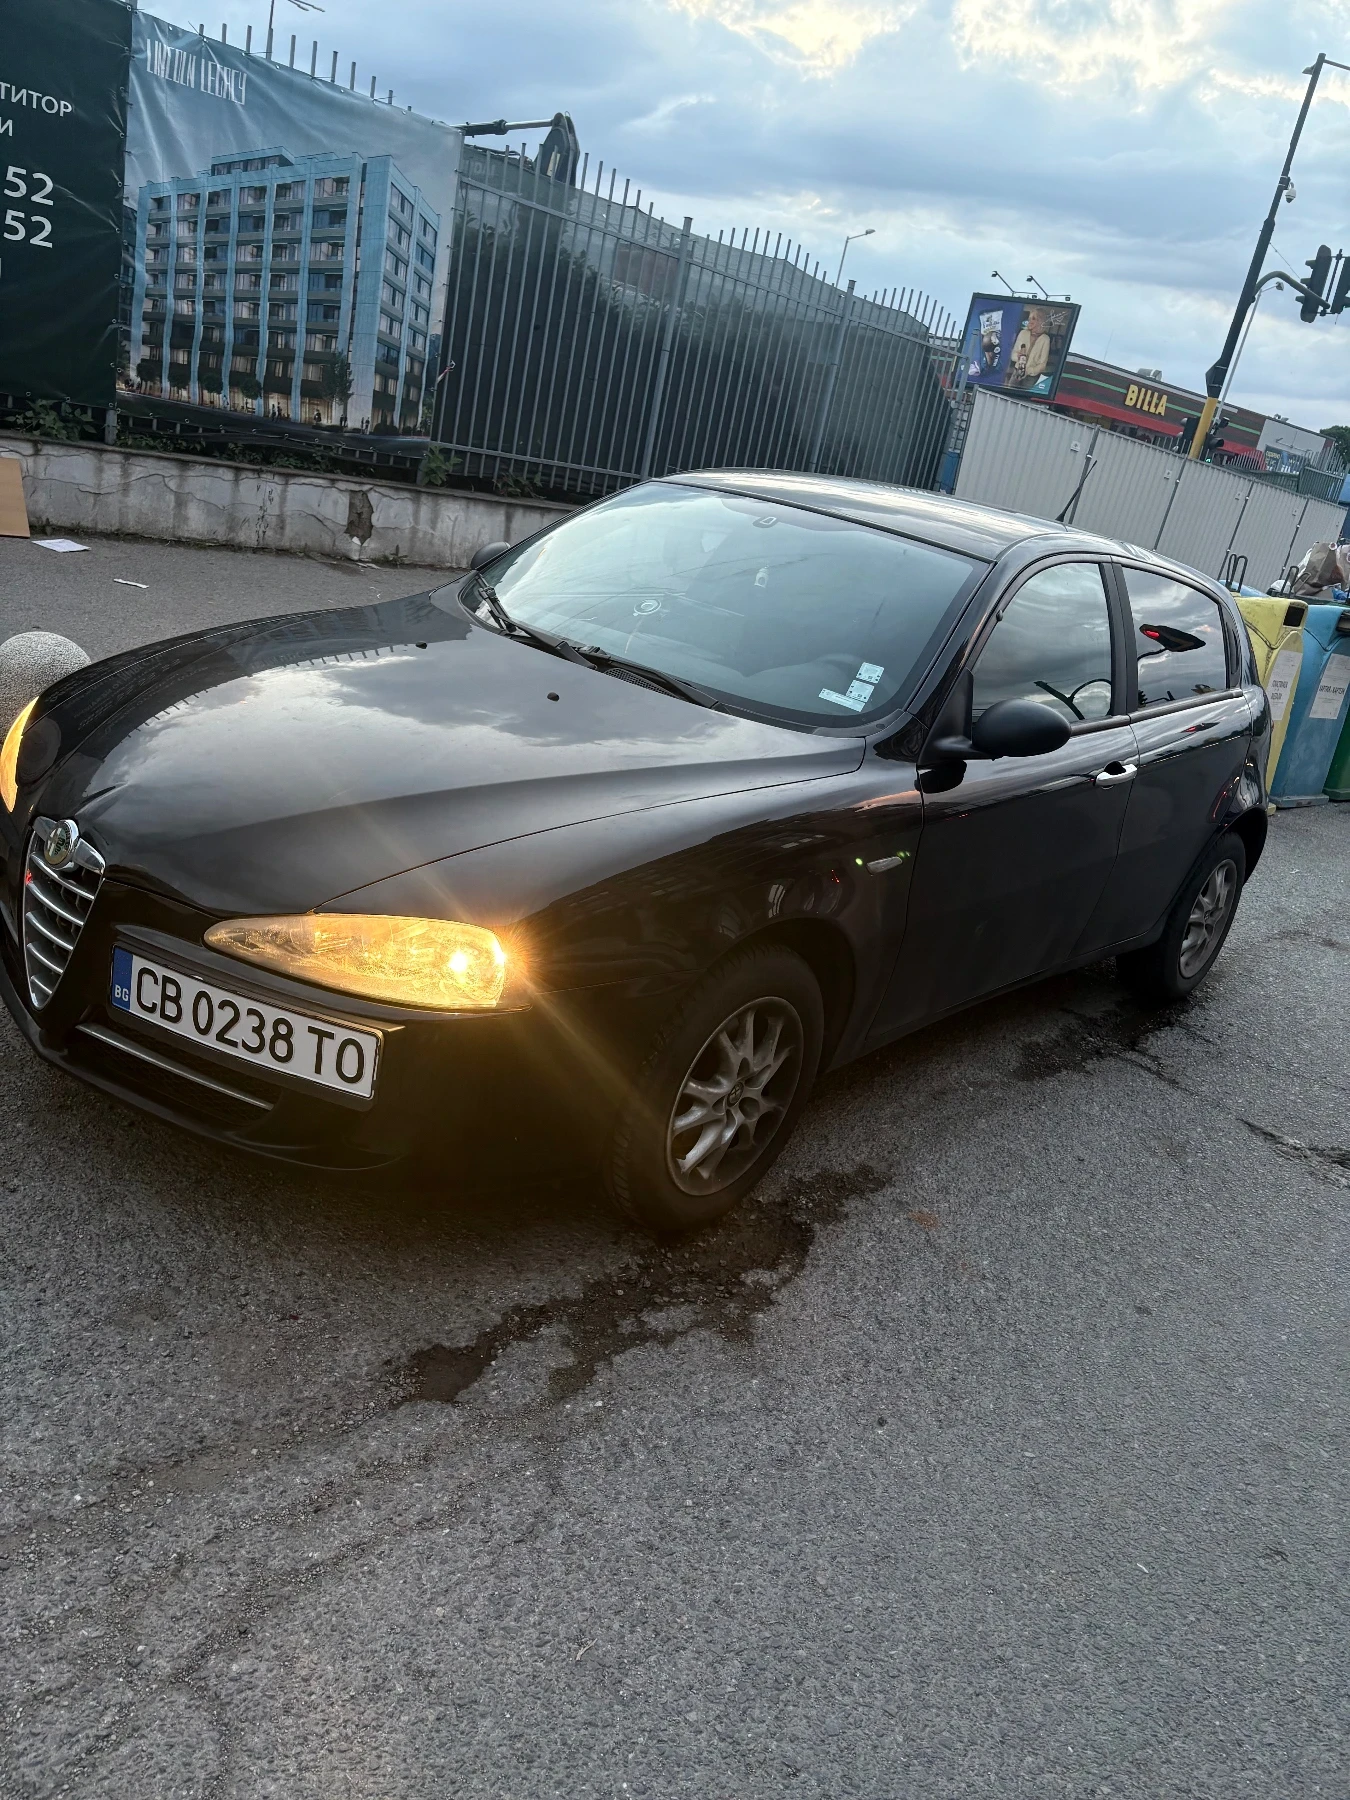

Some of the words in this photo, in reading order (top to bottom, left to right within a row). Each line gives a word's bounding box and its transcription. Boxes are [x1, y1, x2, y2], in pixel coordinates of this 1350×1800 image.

[146, 38, 197, 89] LINCOLN
[200, 58, 247, 106] LEGACY
[0, 81, 73, 117] ТИТОР
[3, 165, 54, 206] 52
[3, 208, 53, 249] 52
[1124, 384, 1168, 417] BILLA
[113, 983, 130, 1003] BG
[135, 965, 183, 1024] CB
[191, 989, 294, 1064] 0238
[306, 1024, 365, 1085] TO
